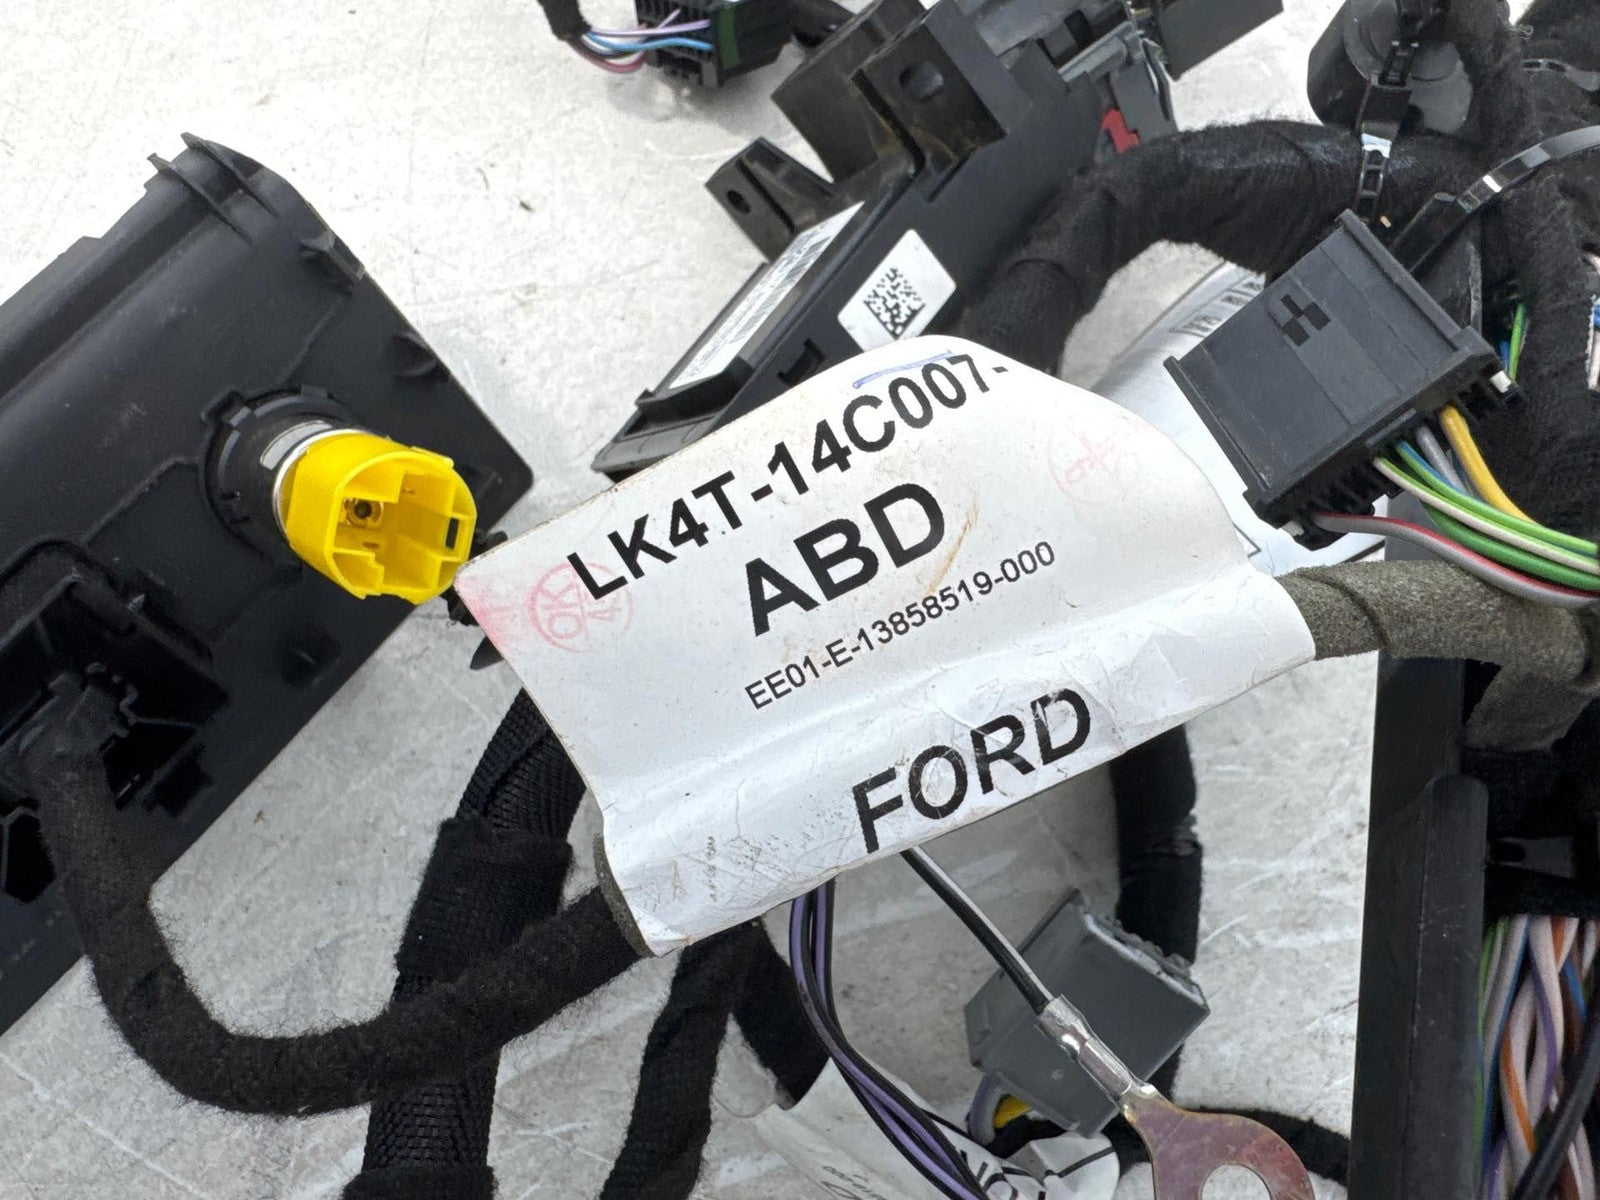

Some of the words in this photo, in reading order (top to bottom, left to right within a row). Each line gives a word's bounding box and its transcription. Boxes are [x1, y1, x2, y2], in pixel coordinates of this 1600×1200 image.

[566, 353, 1009, 600] LK4T-14C007-
[745, 482, 946, 637] ABD
[744, 541, 1056, 710] EE01-E-13858519-000
[851, 687, 1091, 854] FORD
